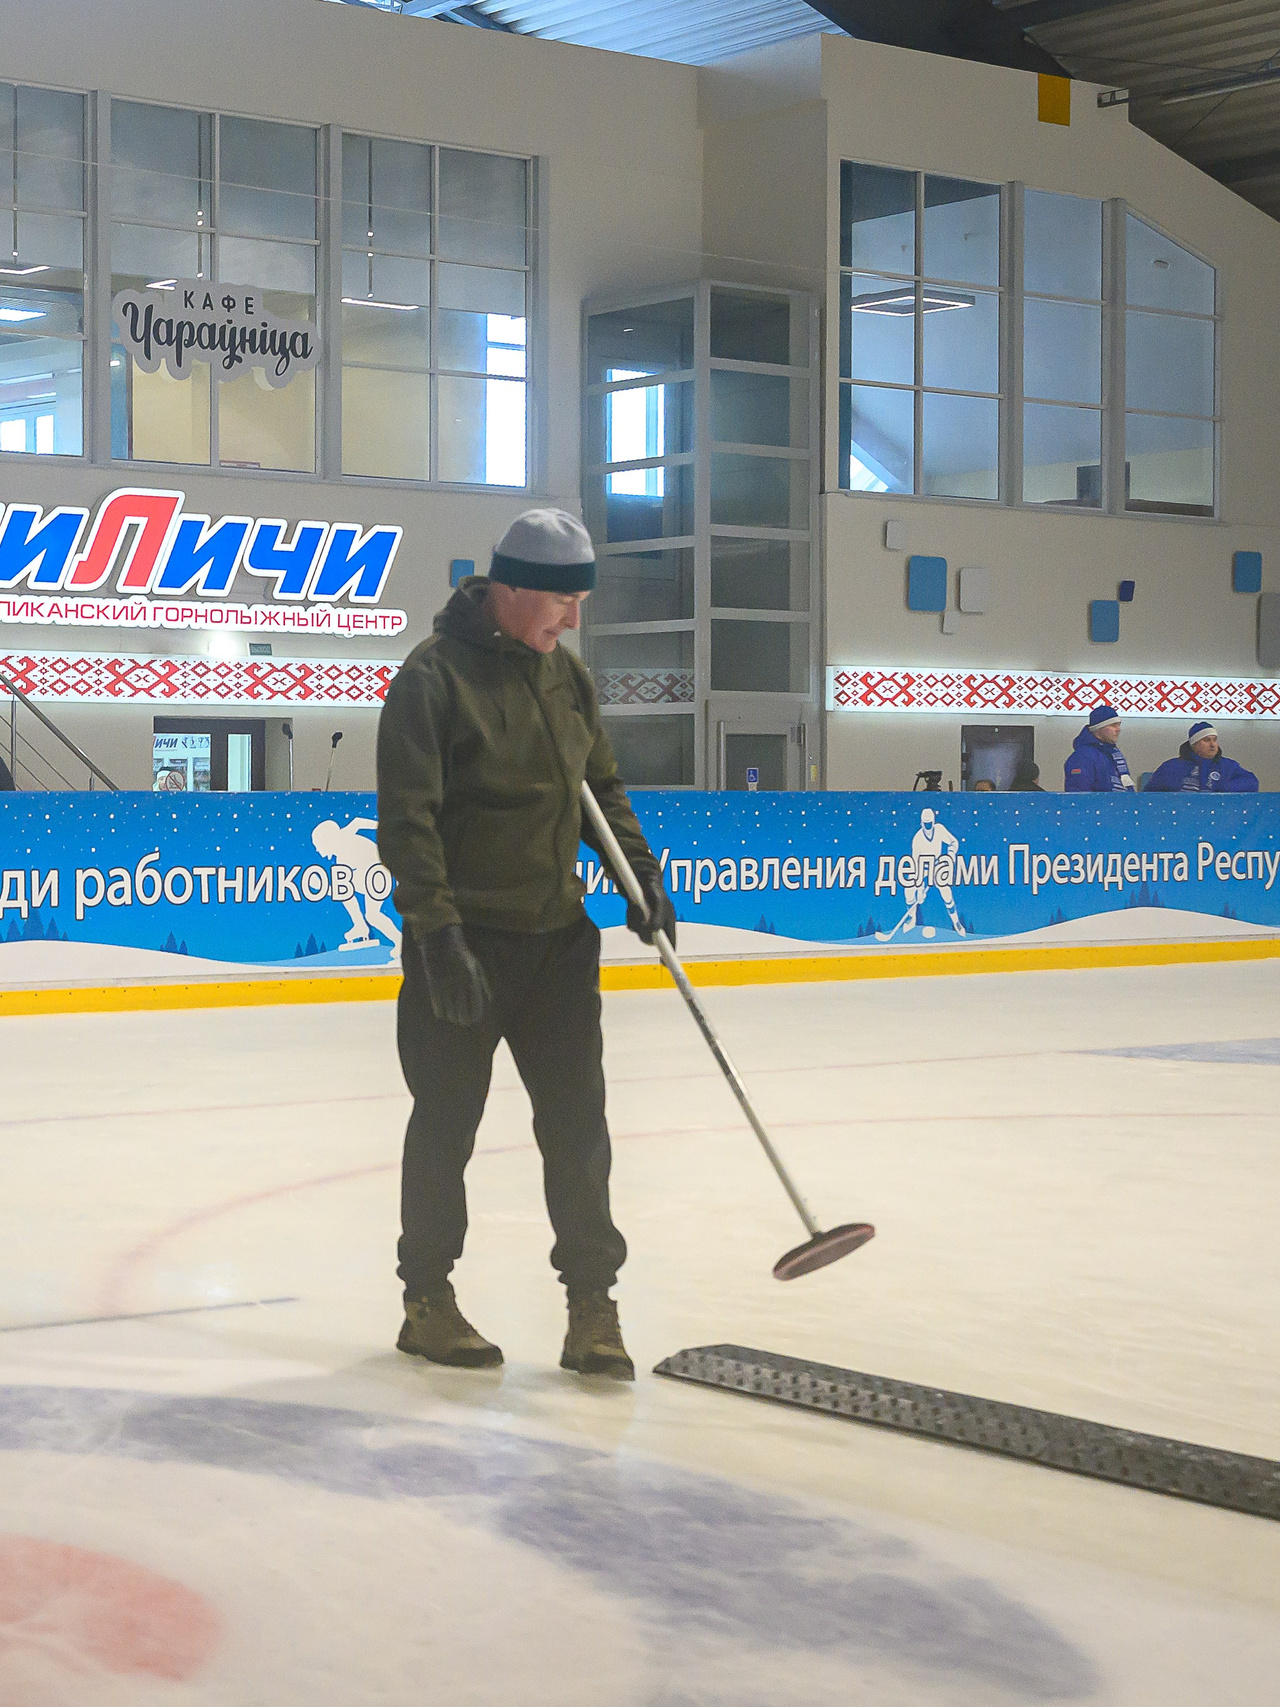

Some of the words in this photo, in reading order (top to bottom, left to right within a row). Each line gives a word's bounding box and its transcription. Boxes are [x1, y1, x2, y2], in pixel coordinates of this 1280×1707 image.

[183, 289, 255, 315] КАФЕ
[122, 301, 313, 376] Чараўніца
[153, 607, 330, 628] ГОРНОЛЫЖНЫЙ
[337, 613, 403, 631] ЦЕНТР
[75, 851, 355, 921] работников
[875, 851, 1000, 896] делами
[1008, 843, 1189, 895] Президента
[1197, 841, 1280, 891] Респу
